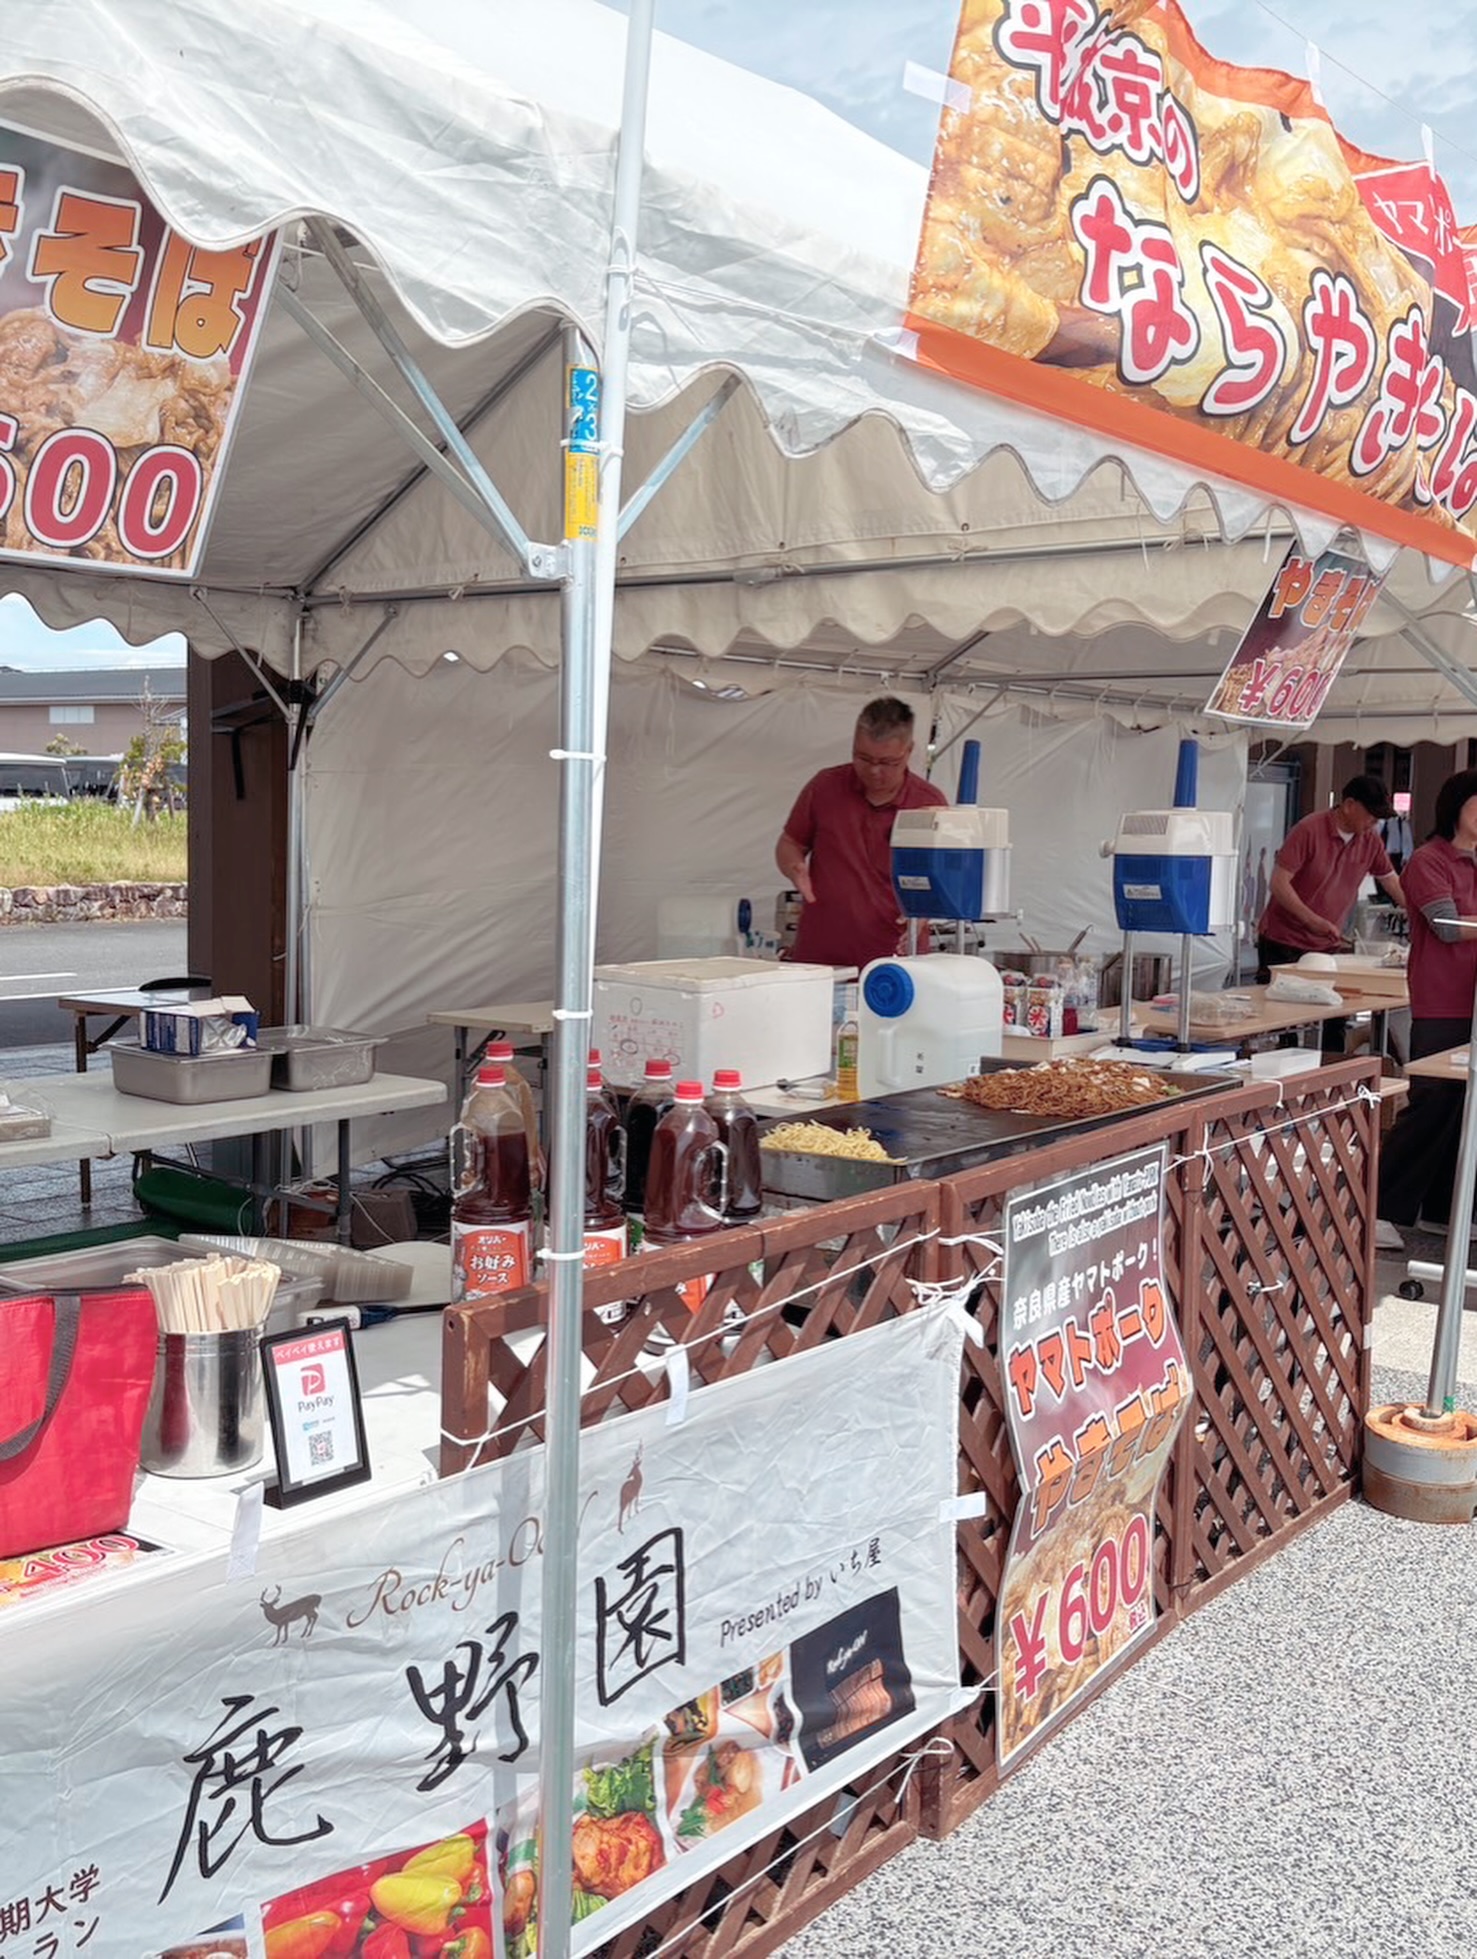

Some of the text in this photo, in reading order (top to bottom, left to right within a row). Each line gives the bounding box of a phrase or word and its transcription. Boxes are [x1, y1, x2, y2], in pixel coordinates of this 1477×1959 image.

[0, 163, 264, 361] そば
[0, 410, 203, 560] 00
[470, 1254, 516, 1271] お好み
[477, 1272, 509, 1285] ソース
[297, 1394, 334, 1413] PayPay
[22, 1534, 140, 1579] 400
[346, 1491, 598, 1628] Rock-ya-O
[720, 1537, 883, 1648] Presented by いち屋
[1010, 1512, 1149, 1700] ¥600
[0, 1916, 100, 1959] ラン
